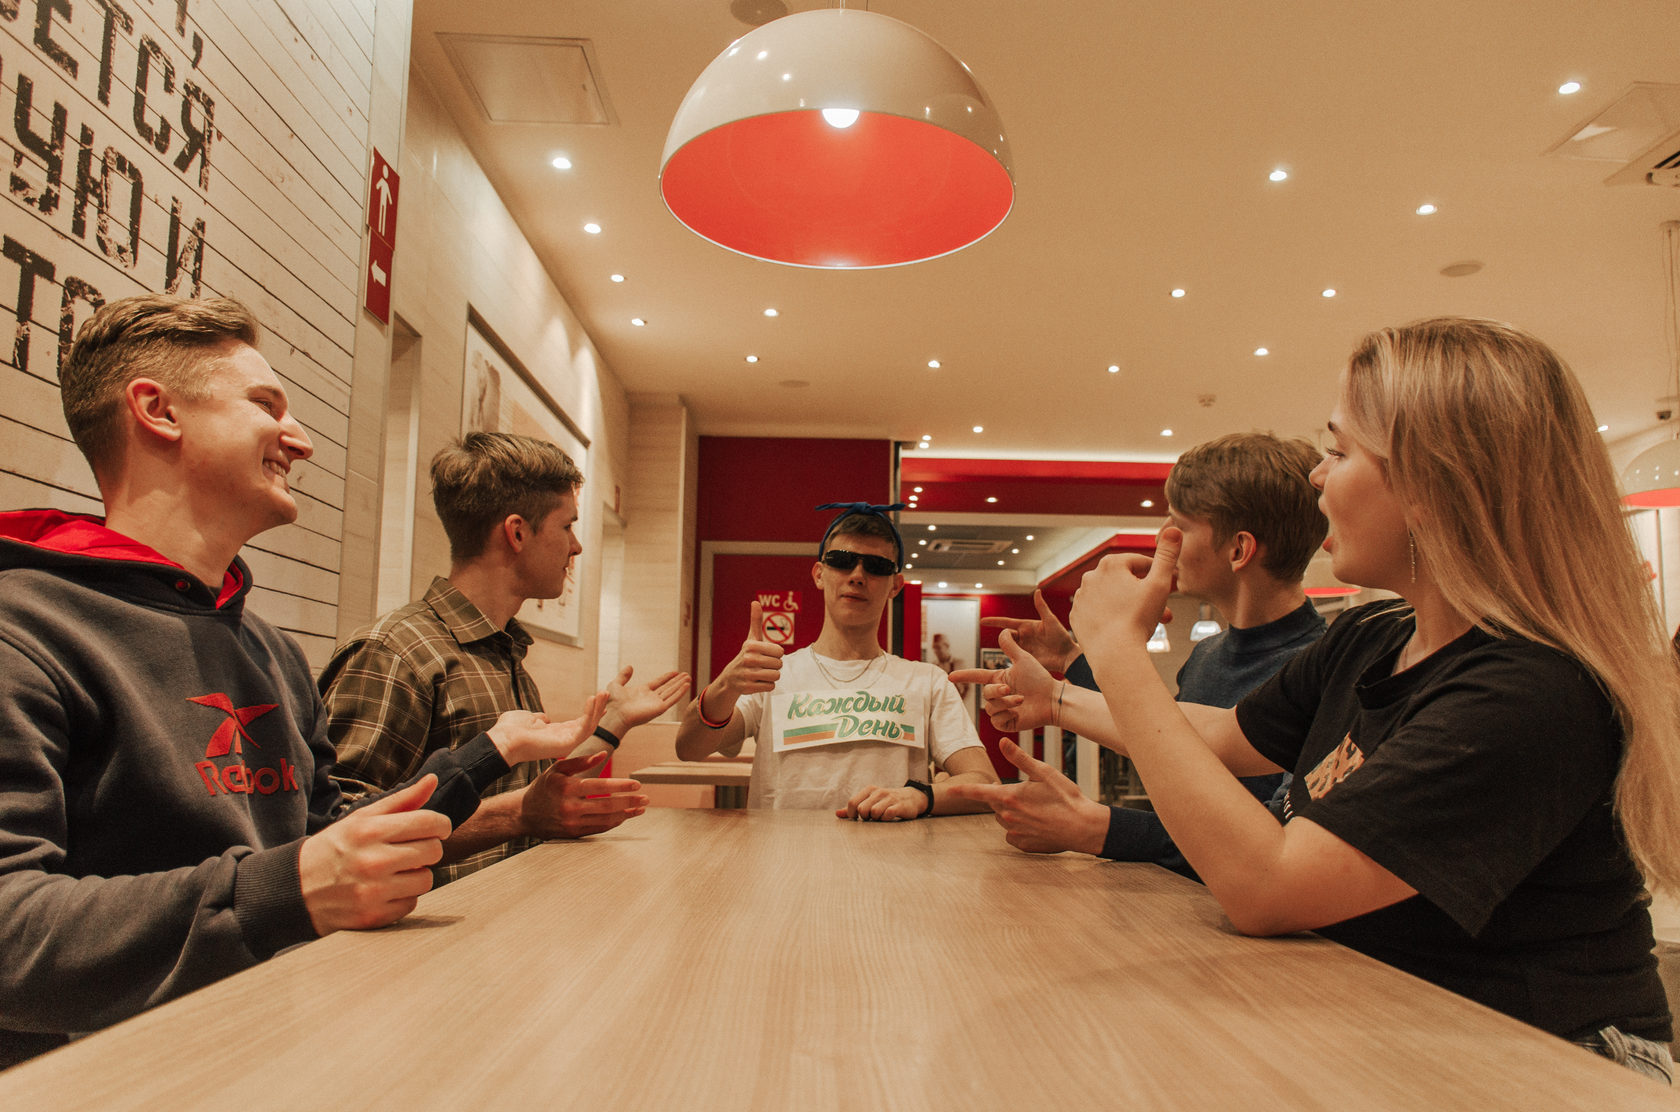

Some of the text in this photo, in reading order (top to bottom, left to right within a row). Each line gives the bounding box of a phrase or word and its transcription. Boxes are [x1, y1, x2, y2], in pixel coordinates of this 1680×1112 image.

[0, 0, 215, 192] ЕТСЯ
[758, 594, 780, 607] WC
[787, 690, 906, 720] Каждый
[832, 714, 901, 739] День
